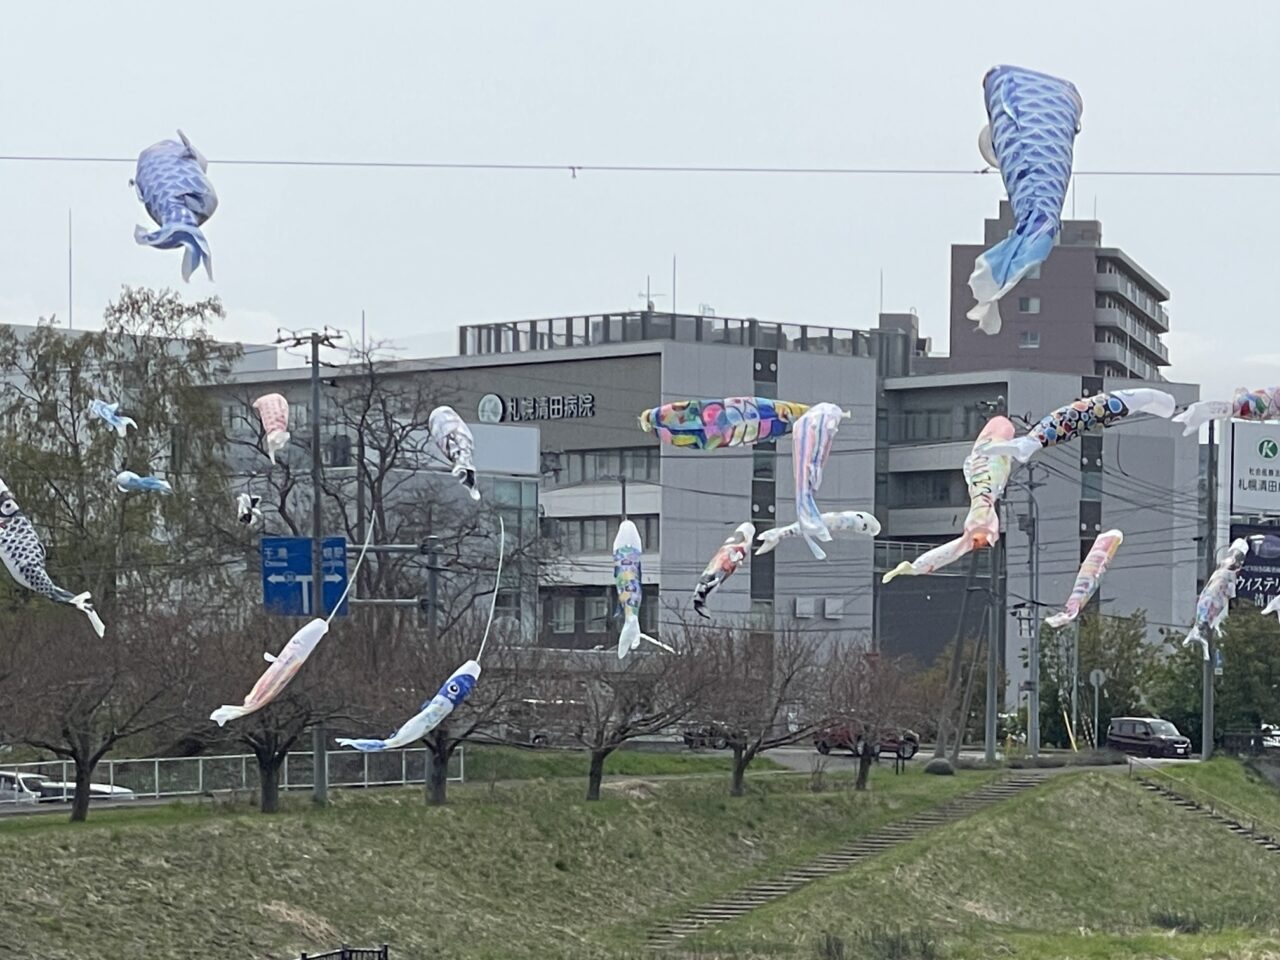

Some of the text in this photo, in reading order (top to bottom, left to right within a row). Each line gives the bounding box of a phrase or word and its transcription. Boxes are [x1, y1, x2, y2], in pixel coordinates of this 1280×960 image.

[506, 394, 594, 421] 札幌清田病院
